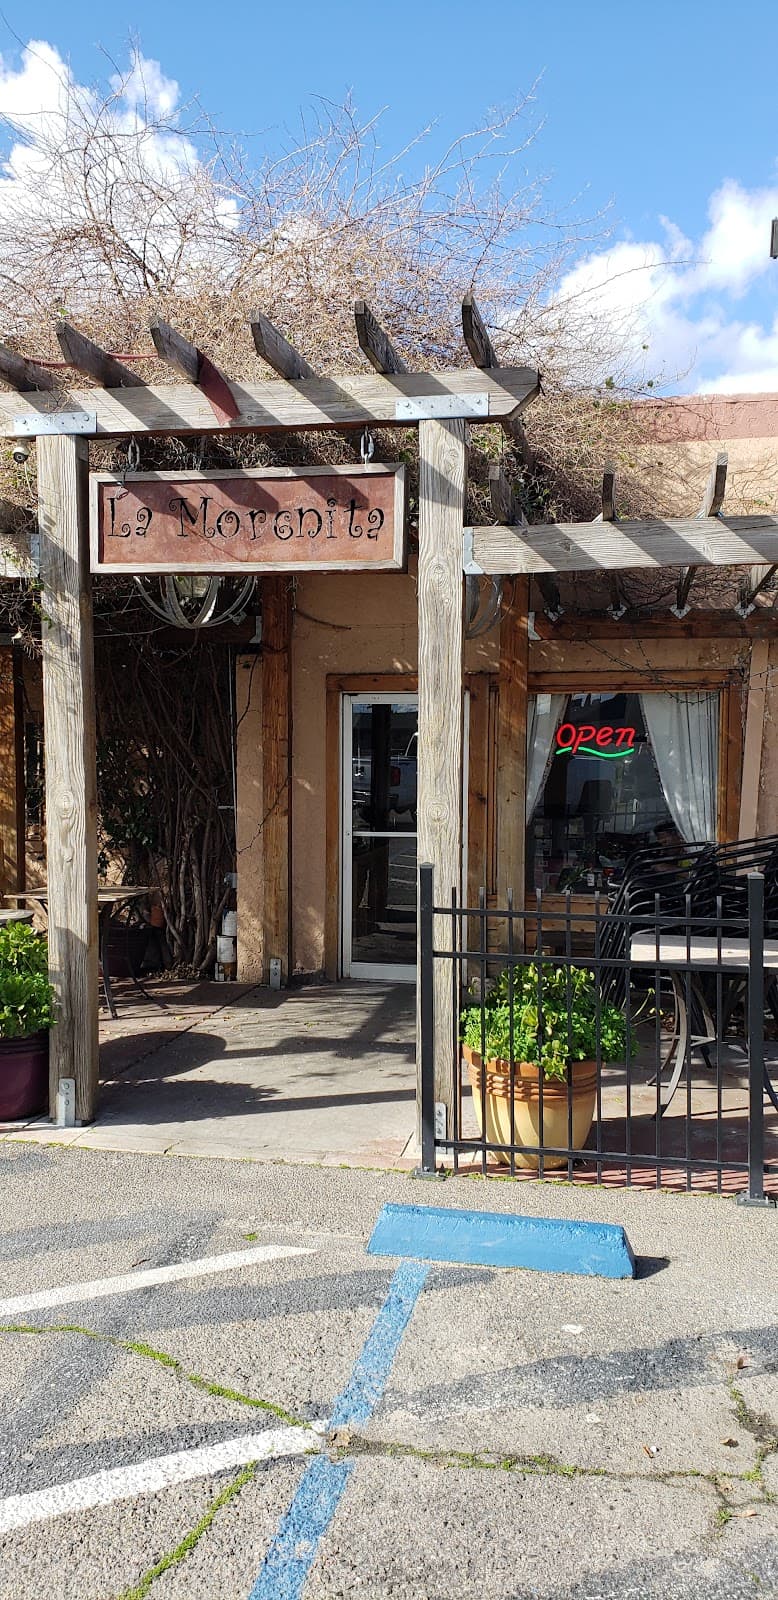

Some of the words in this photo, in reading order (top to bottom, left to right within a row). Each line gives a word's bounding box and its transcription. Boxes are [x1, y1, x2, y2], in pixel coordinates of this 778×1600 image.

[106, 497, 153, 538] La
[168, 496, 385, 542] Morenita
[555, 723, 636, 754] Open
